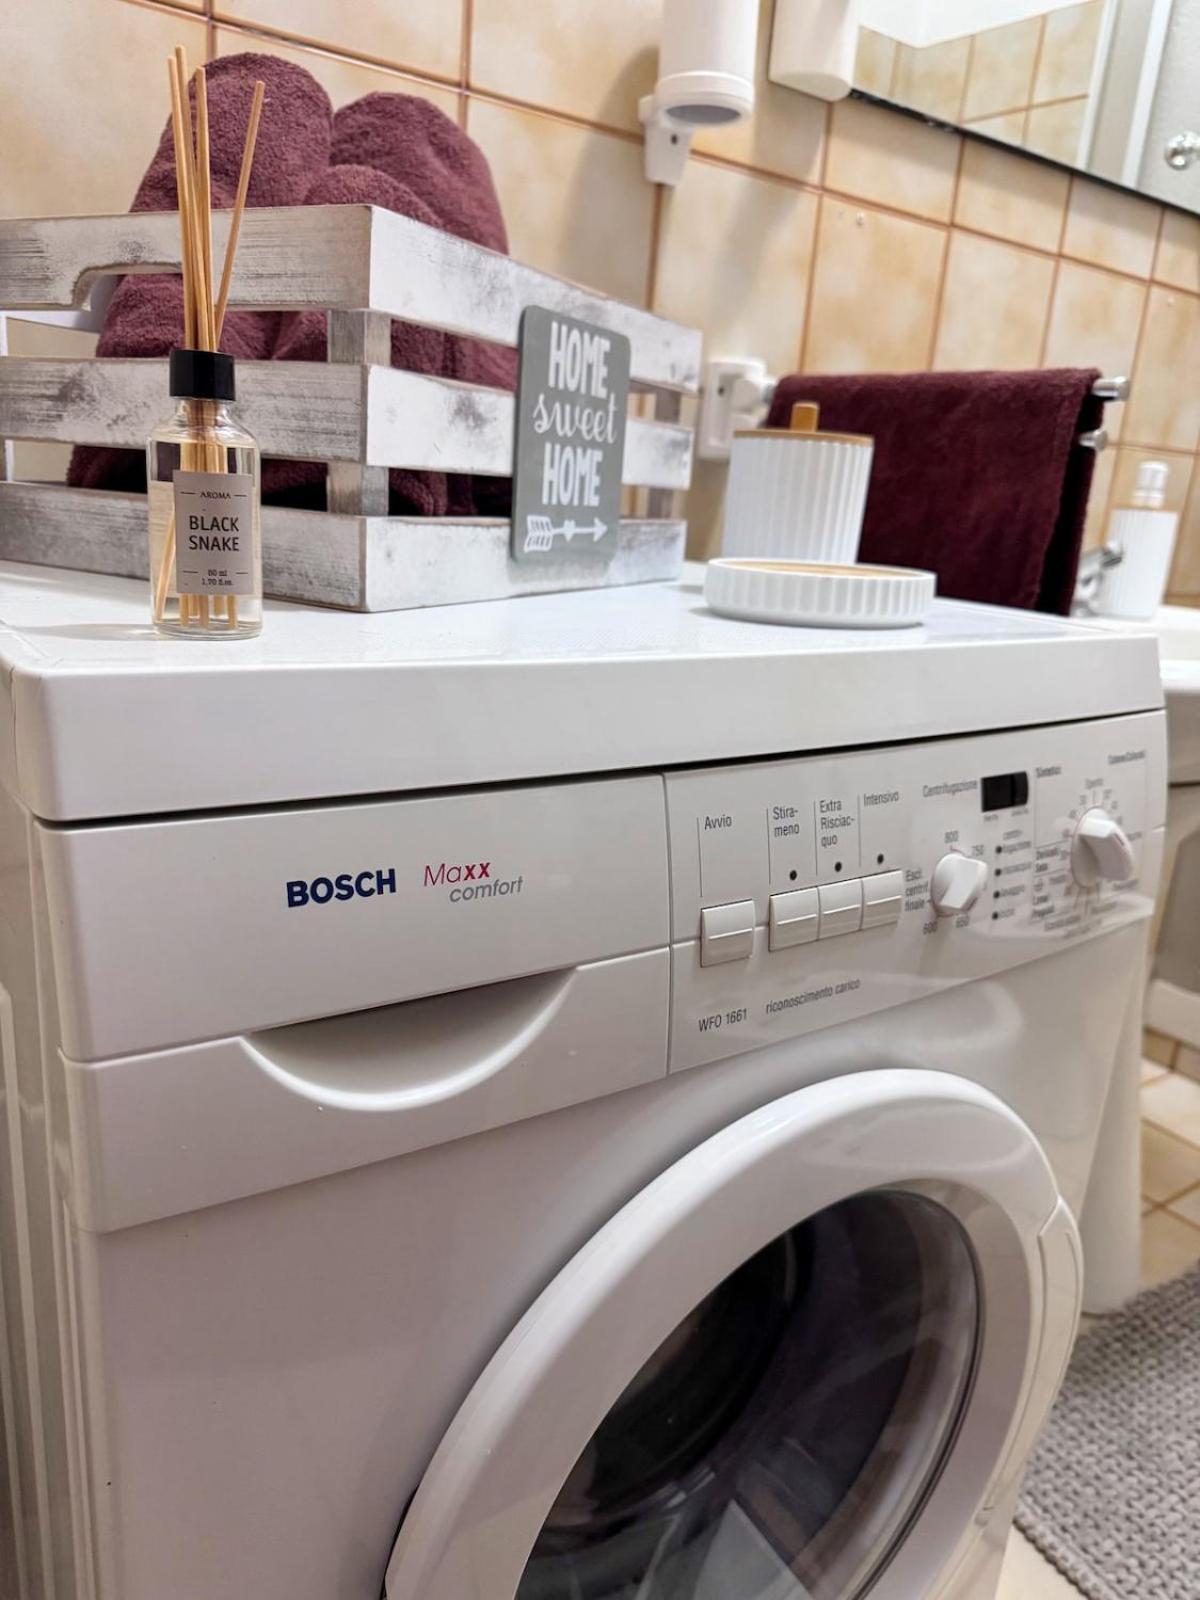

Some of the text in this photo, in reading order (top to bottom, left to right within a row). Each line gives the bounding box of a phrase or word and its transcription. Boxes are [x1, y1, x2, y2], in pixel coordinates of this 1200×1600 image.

[548, 320, 611, 399] HOME
[533, 392, 617, 444] sweet
[542, 442, 603, 507] HOME
[200, 491, 231, 499] AROMA
[189, 515, 239, 532] BLACK
[188, 535, 240, 551] SNAKE
[922, 780, 978, 798] Centrifugazione
[819, 800, 842, 814] Extra
[863, 791, 900, 807] Intensivo
[772, 806, 799, 820] Stira-
[704, 815, 733, 831] Avvio
[820, 814, 855, 830] Risciac-
[774, 823, 800, 838] meno
[944, 830, 959, 844] 800
[821, 834, 838, 848] quo
[423, 862, 491, 887] Maxx
[286, 868, 397, 909] BOSCH
[449, 876, 523, 902] comfort
[922, 920, 938, 935] 600
[765, 978, 861, 1014] riconoscimento carico
[698, 1008, 748, 1032] WFO 1661
